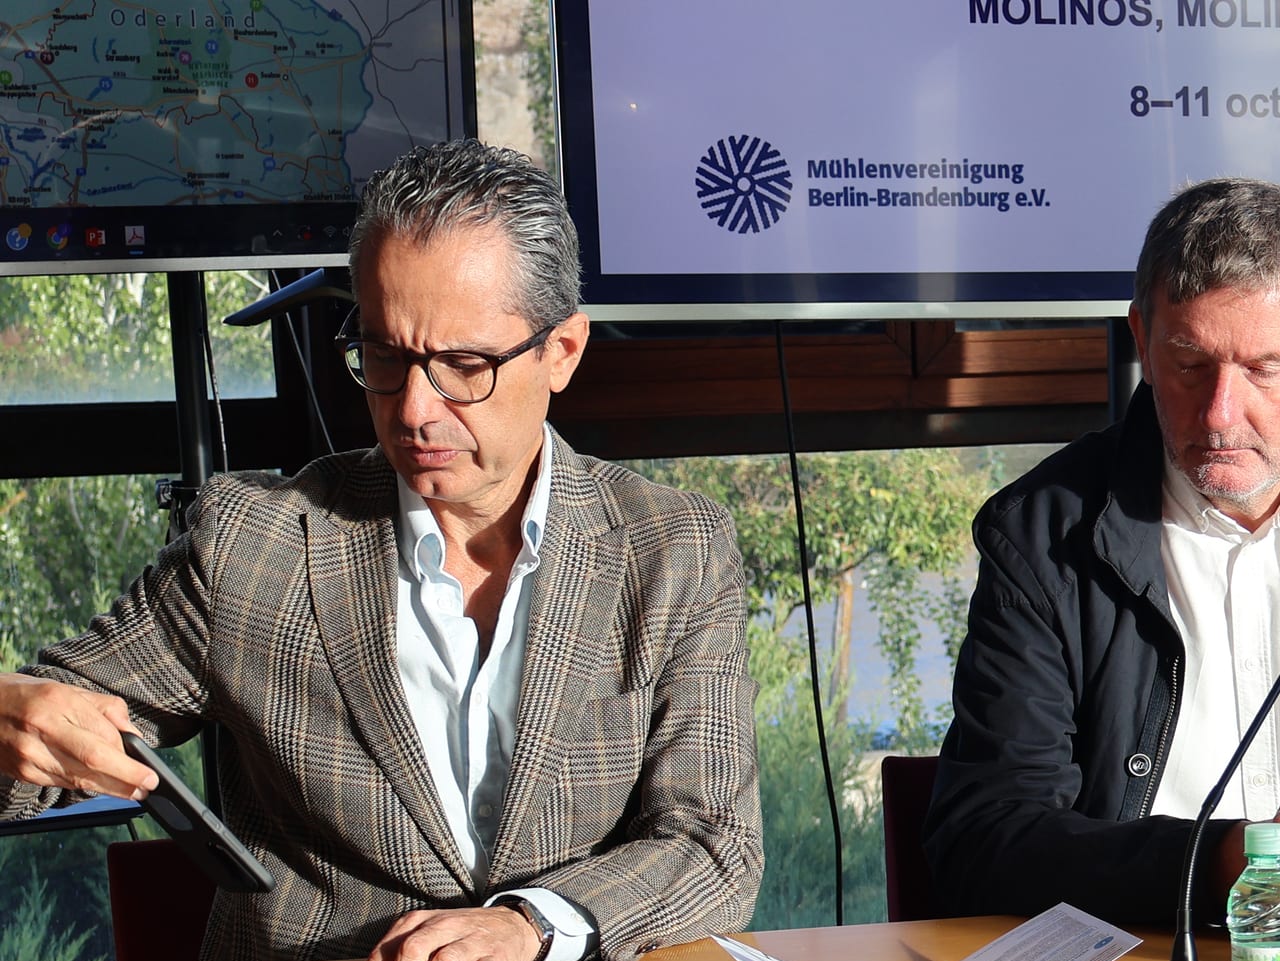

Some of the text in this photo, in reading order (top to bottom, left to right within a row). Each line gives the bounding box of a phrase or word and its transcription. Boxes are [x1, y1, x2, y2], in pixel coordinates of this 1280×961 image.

[110, 9, 256, 28] Oderland
[969, 0, 1163, 32] MOLINOS,
[807, 158, 1024, 184] Mühlenvereinigung
[808, 187, 1051, 211] Berlin-Brandenburg e.V.
